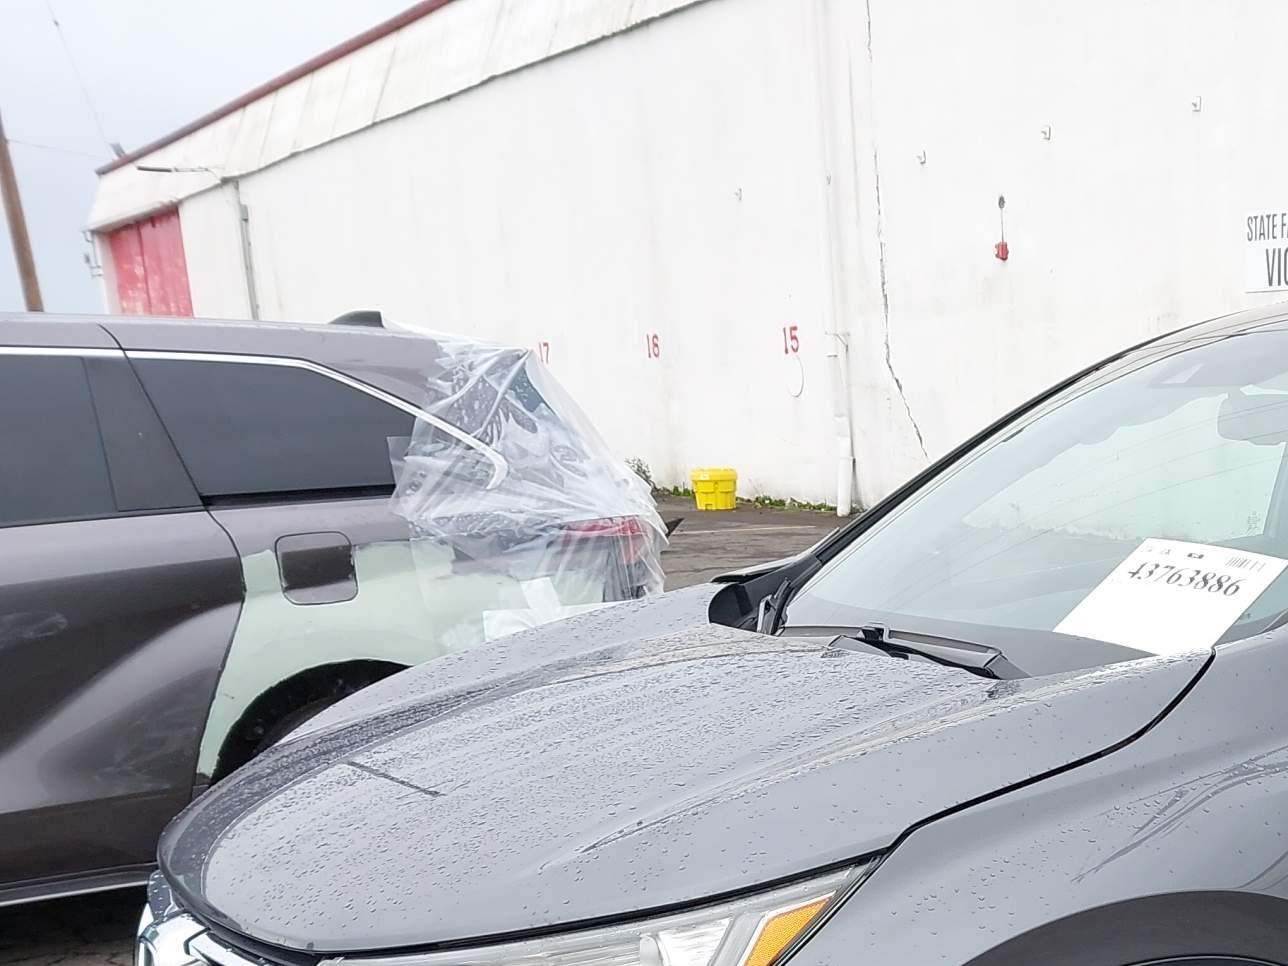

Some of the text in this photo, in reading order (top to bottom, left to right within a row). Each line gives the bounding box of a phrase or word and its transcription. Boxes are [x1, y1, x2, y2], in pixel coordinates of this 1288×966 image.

[1247, 213, 1278, 242] STATE
[538, 341, 550, 364] 17
[645, 333, 660, 359] 16
[782, 326, 800, 355] 15
[1127, 561, 1248, 596] 43763886
